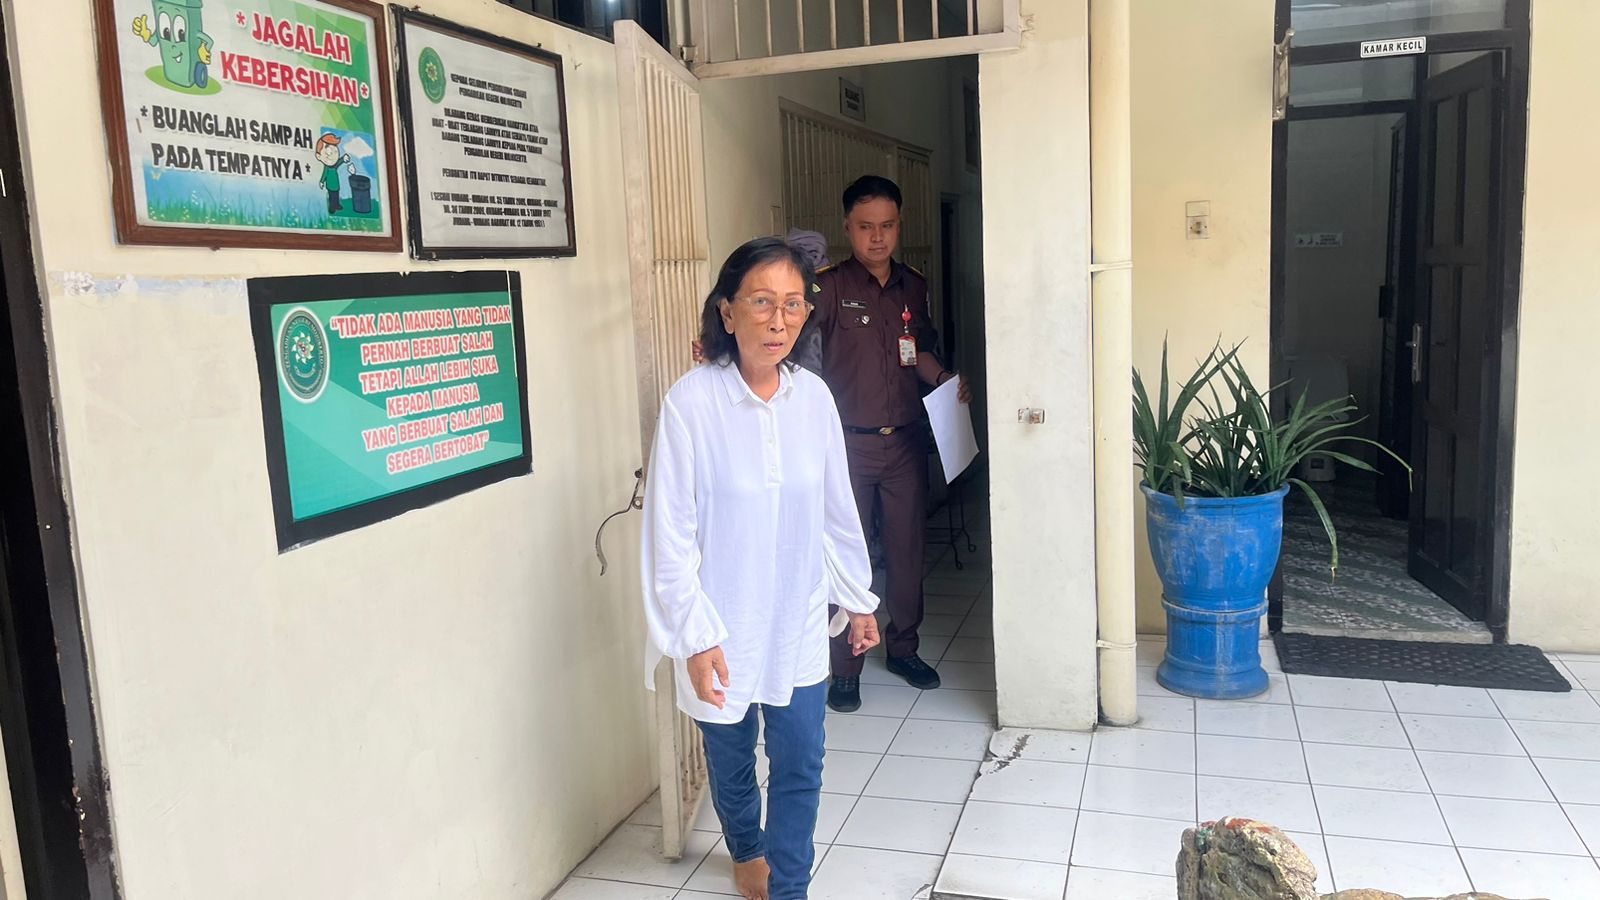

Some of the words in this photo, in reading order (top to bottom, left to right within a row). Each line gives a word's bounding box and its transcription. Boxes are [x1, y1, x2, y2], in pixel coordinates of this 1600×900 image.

[252, 13, 350, 62] JAGALAH
[1364, 44, 1394, 53] KAMAR
[1397, 41, 1422, 50] KECIL
[220, 51, 359, 104] KEBERSIHAN
[152, 106, 247, 140] BUANGLAH
[250, 120, 312, 149] SAMPAH
[152, 143, 203, 170] PADA
[206, 150, 302, 180] TEMPATNYA
[379, 314, 402, 333] ADA
[405, 310, 452, 330] MANUSIA
[455, 308, 480, 326] YANG
[483, 305, 510, 323] TIDAK
[362, 342, 409, 364] PERNAH
[412, 337, 460, 358] BERBUAT
[462, 332, 493, 351] SALAH
[360, 372, 400, 393] TETAPI
[406, 368, 440, 388] ALLAH
[442, 362, 471, 382] LEBIH
[473, 357, 498, 375] SUKA
[387, 396, 431, 417] KEPADA
[434, 384, 479, 407] MANUSIA
[363, 429, 396, 450] YANG
[400, 418, 448, 442] BERBUAT
[450, 409, 482, 430] SALAH
[485, 405, 503, 422] DAN
[388, 451, 432, 472] SEGERA
